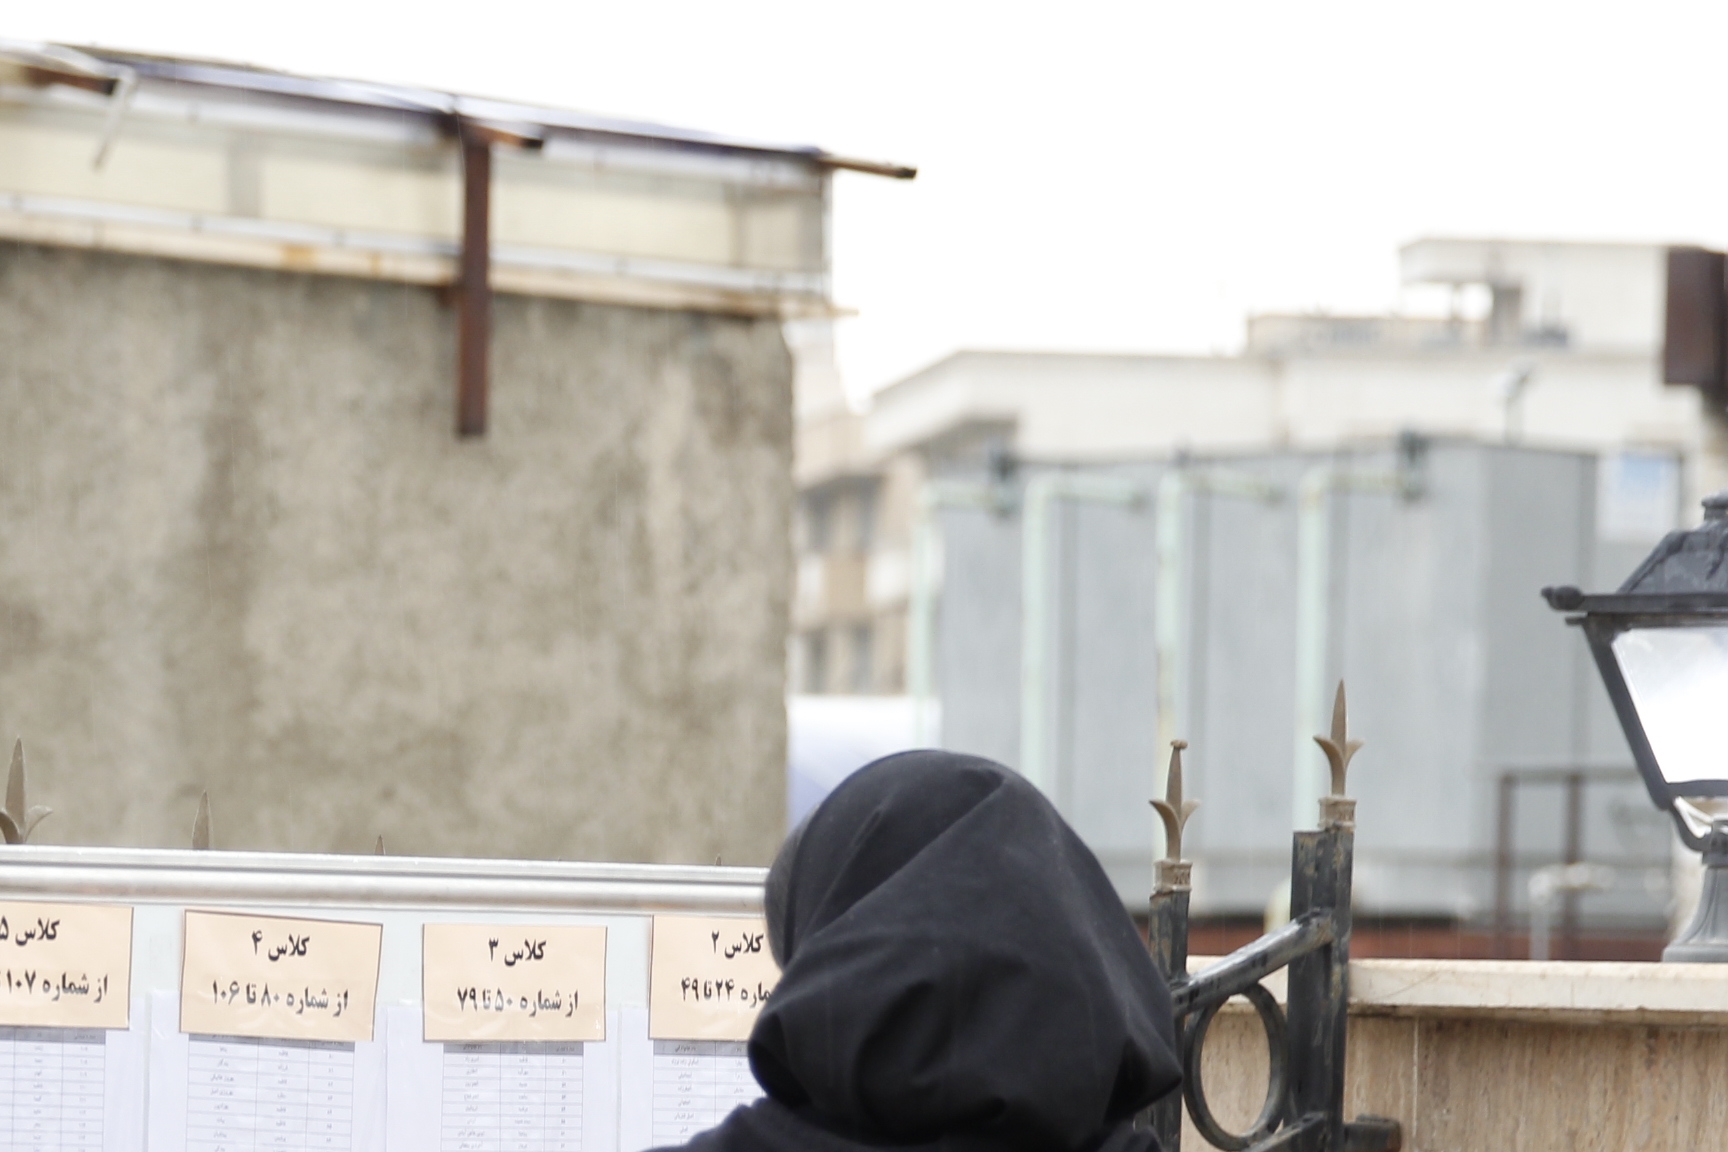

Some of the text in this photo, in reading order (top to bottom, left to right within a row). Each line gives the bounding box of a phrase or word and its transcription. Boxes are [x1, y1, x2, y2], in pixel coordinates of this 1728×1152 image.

[14, 917, 61, 947] کلاس
[251, 929, 311, 963] کلاس ۴
[711, 930, 765, 960] کلاس ۲
[488, 938, 547, 968] کلاس ۳
[6, 968, 37, 994] ۱۰۷
[42, 971, 90, 1002] شماره
[93, 973, 109, 1004] از
[680, 977, 772, 1008] ماره ۲۴ تا ۴۹
[212, 979, 349, 1018] از شماره ۸۰ تا ۱۰۶
[456, 986, 579, 1018] از شماره ۵۰ تا ۷۹
